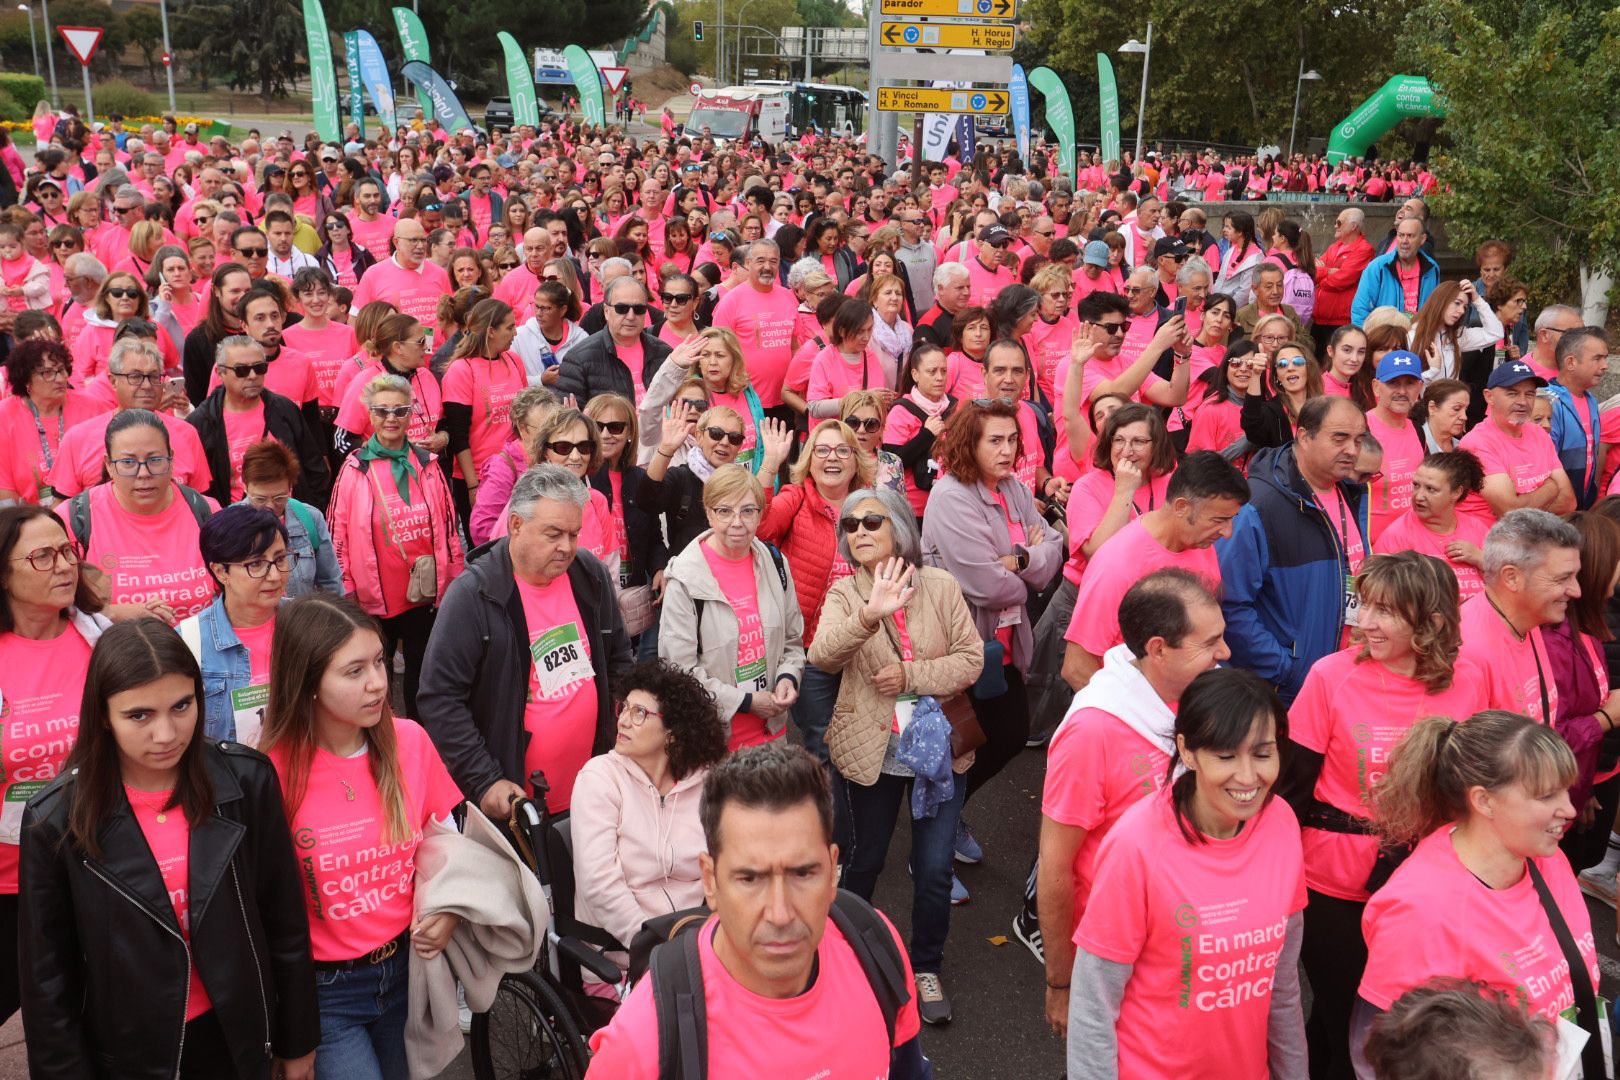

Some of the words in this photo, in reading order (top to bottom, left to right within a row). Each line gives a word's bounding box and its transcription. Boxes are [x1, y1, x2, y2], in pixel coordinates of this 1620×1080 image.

[984, 28, 1010, 38] Horus
[973, 38, 981, 46] H.
[985, 38, 1010, 48] Regio
[892, 100, 900, 108] P.
[904, 100, 939, 108] Romano
[893, 91, 918, 100] Vincci
[1396, 93, 1421, 102] contra
[1293, 289, 1312, 298] VANS
[402, 305, 431, 314] contra
[760, 328, 786, 338] contra
[116, 572, 140, 588] En
[146, 566, 207, 585] marcha
[116, 588, 192, 605] contra
[195, 582, 211, 598] el
[544, 644, 578, 672] 8236
[10, 721, 40, 739] En
[319, 852, 349, 872] En
[322, 860, 402, 896] contra
[1199, 934, 1228, 954] En
[1179, 936, 1192, 1008] SALAMANCA
[1197, 951, 1278, 982] contra
[1525, 976, 1551, 1000] En
